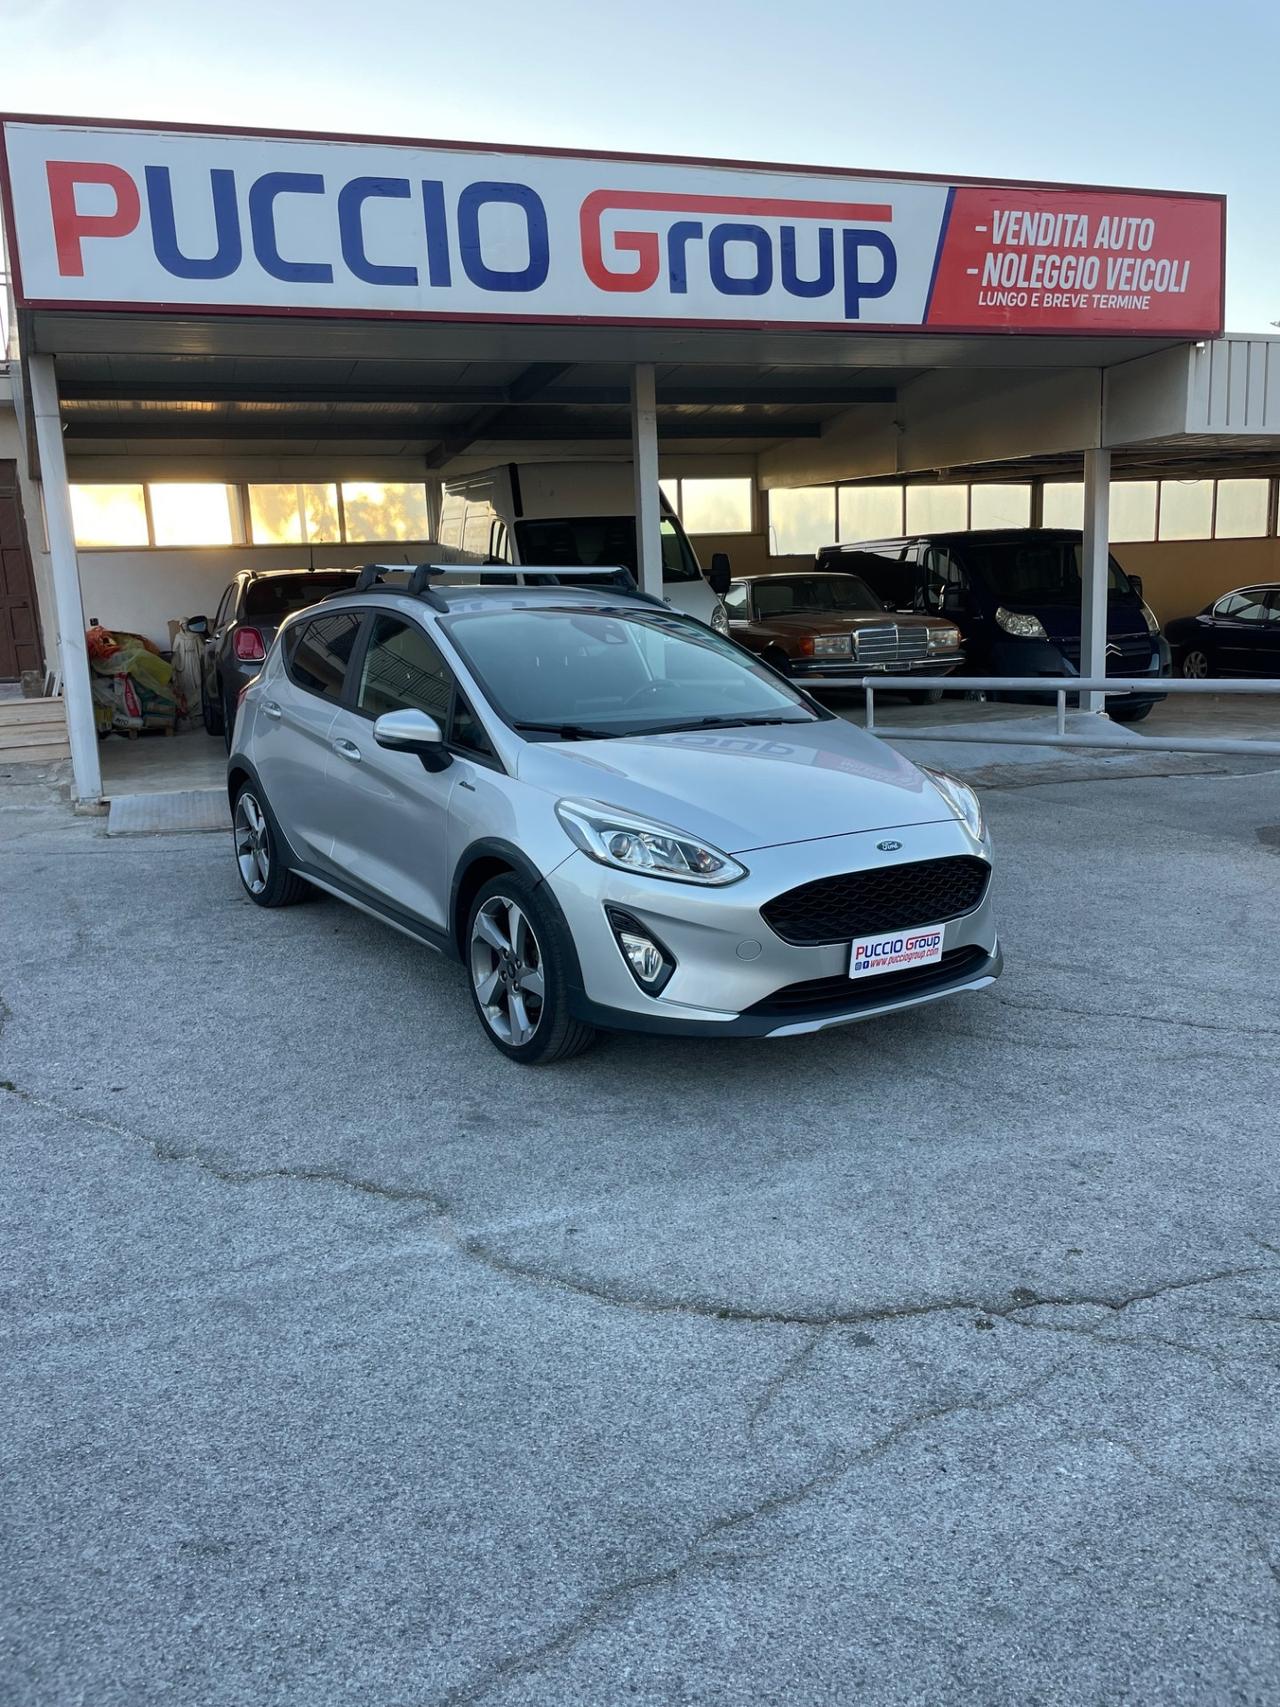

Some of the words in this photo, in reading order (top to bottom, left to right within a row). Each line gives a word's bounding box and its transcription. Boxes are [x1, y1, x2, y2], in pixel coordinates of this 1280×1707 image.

[46, 160, 551, 293] PUCCIO
[579, 188, 898, 319] Group
[1093, 215, 1155, 251] AUTO
[1106, 257, 1190, 293] VEICOLI
[978, 291, 1028, 307] LUNGO
[1031, 293, 1040, 307] E
[1043, 293, 1088, 308] BREVE
[1092, 294, 1151, 310] TERMINE
[856, 939, 904, 960] PUCCIO
[905, 932, 941, 952] Group
